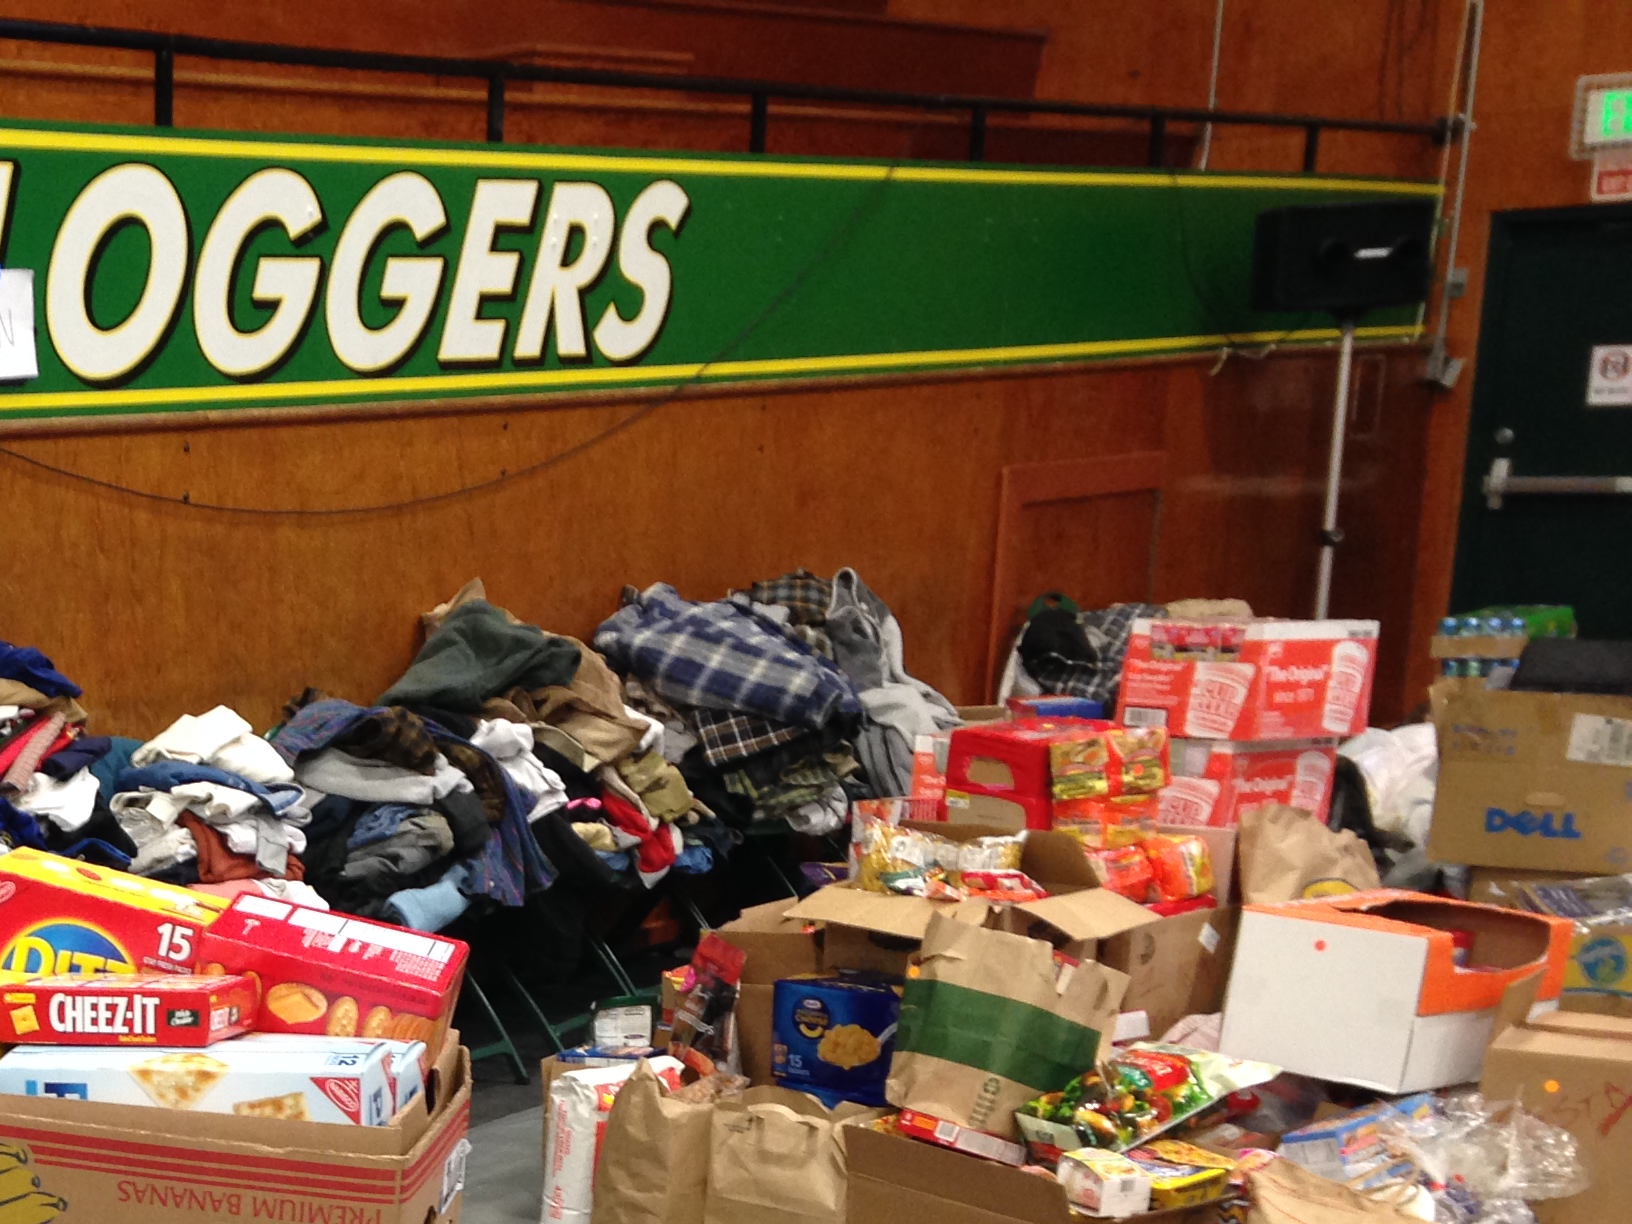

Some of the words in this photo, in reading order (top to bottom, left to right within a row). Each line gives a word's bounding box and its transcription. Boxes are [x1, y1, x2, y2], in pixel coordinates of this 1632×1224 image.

[1484, 806, 1583, 839] DELL
[156, 921, 195, 962] 15
[48, 992, 161, 1035] CHEEZ-IT
[117, 1179, 244, 1217] BANANAS
